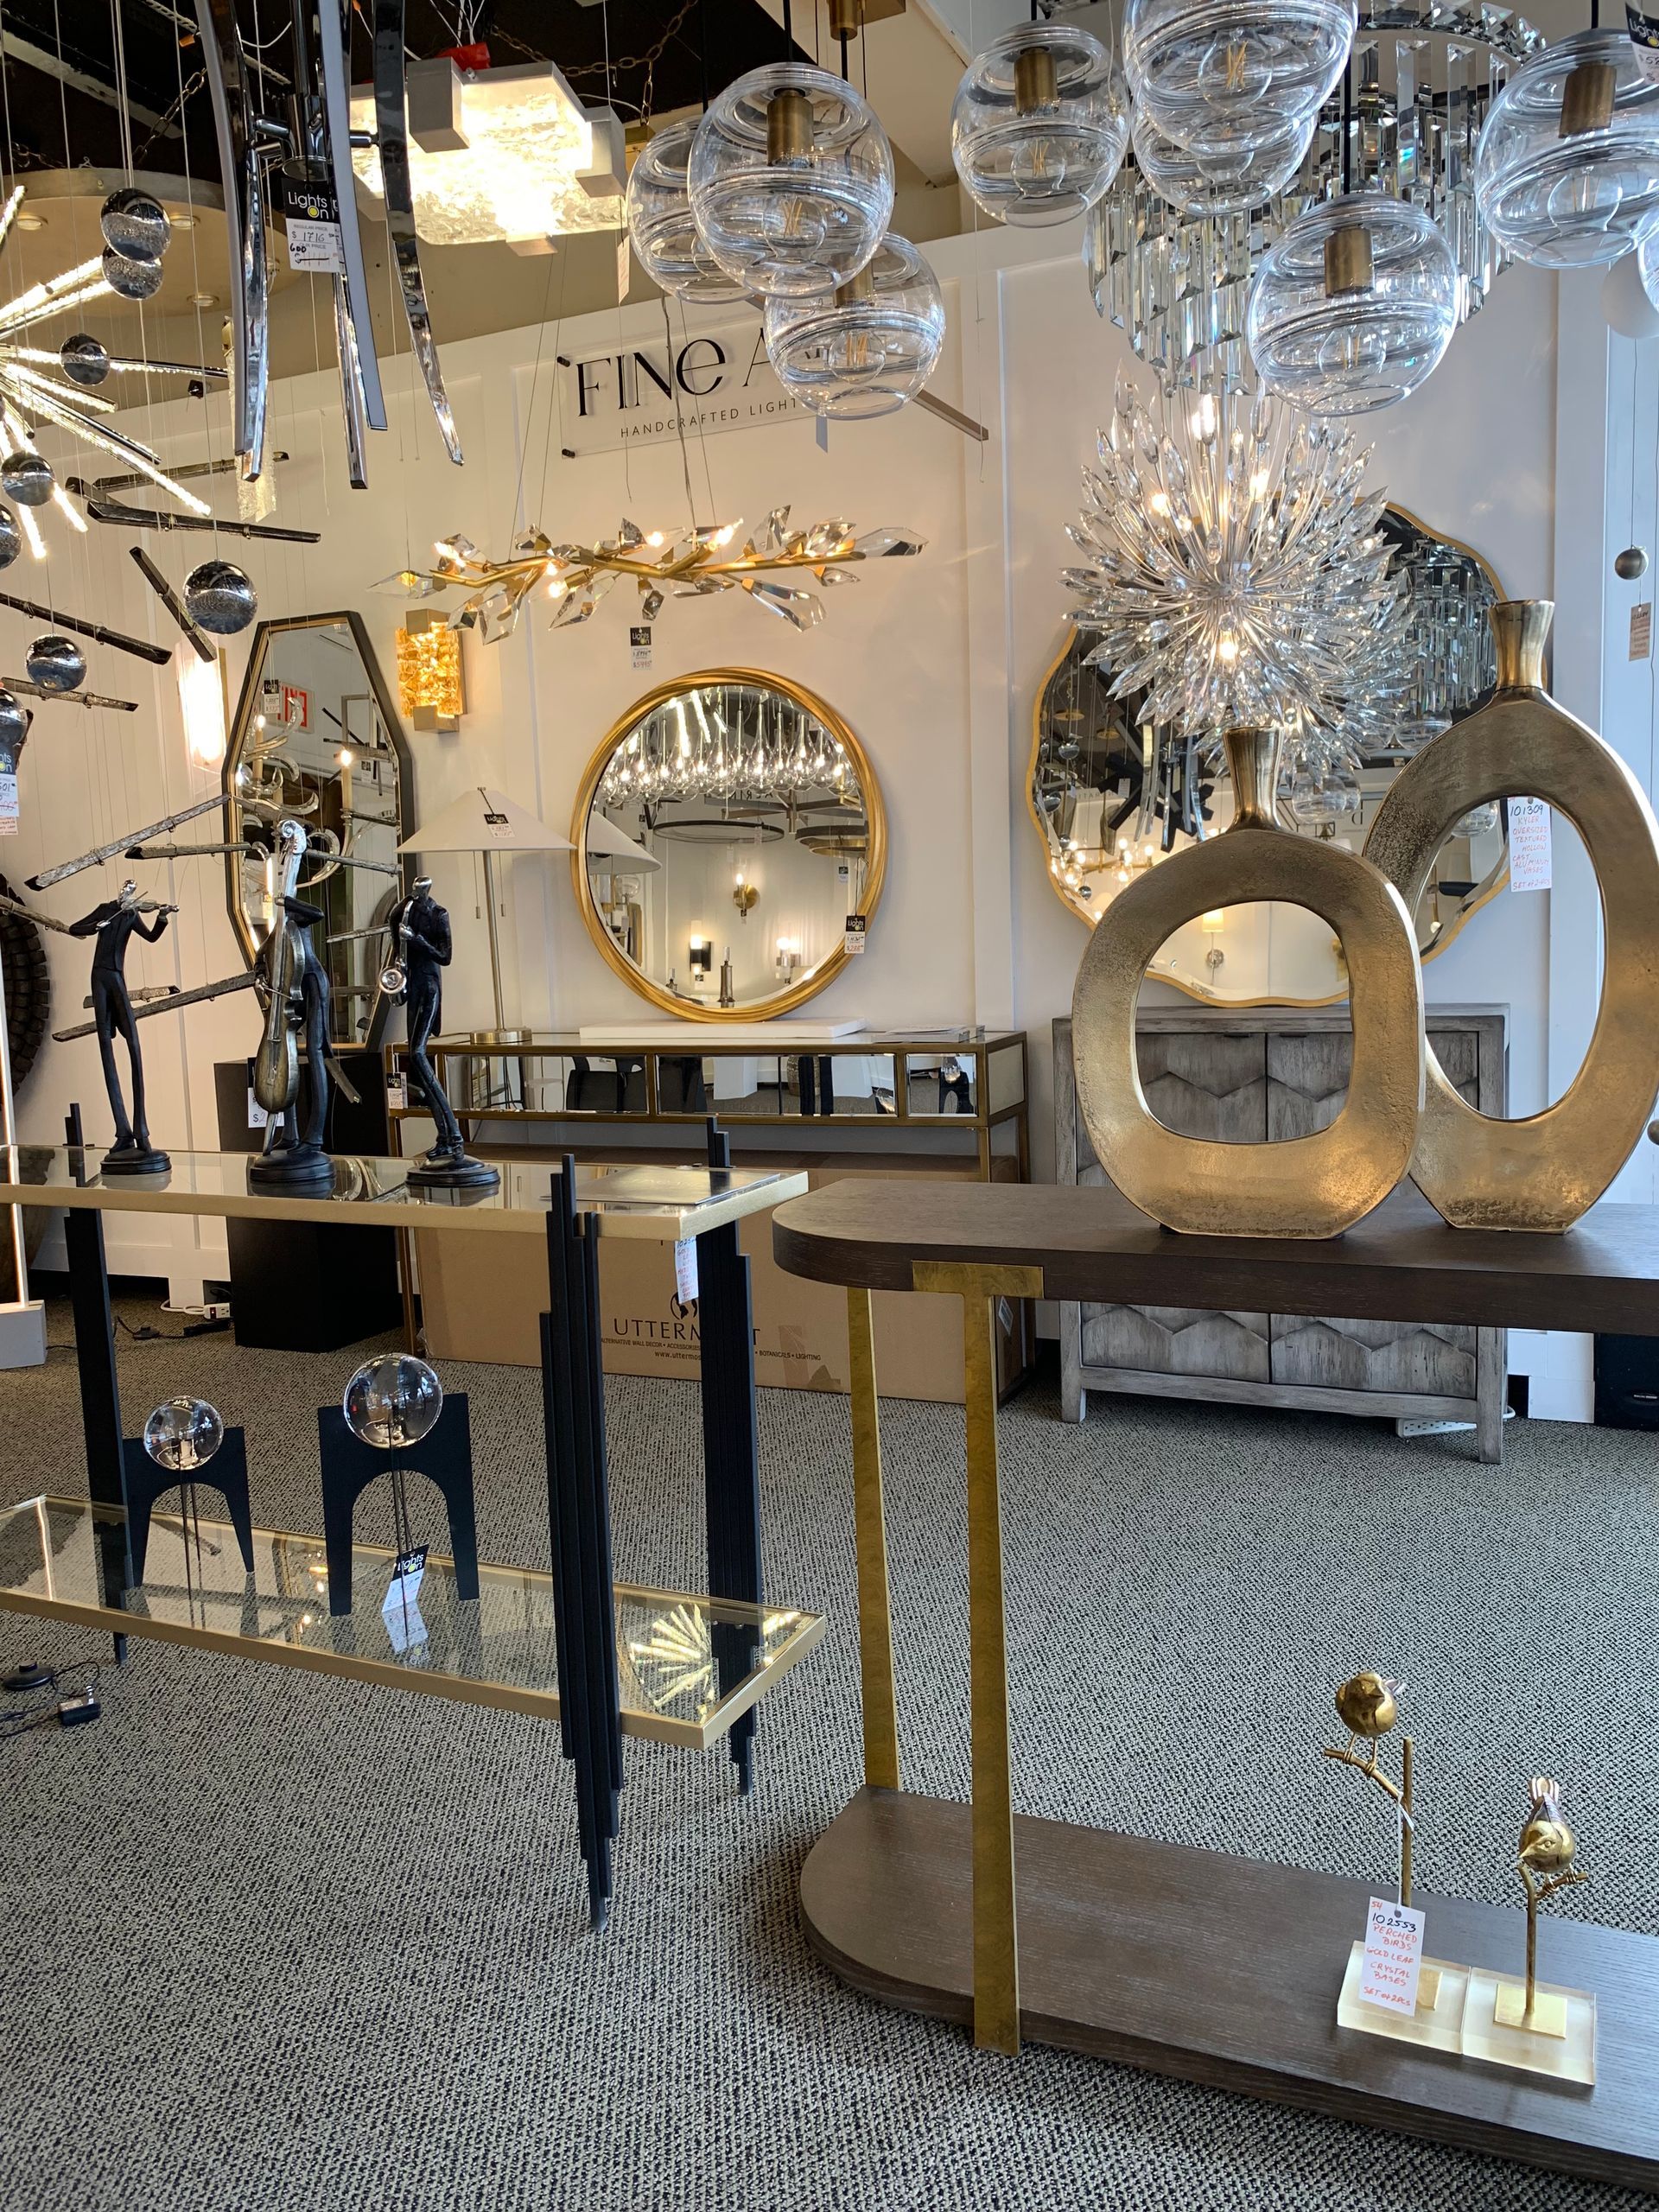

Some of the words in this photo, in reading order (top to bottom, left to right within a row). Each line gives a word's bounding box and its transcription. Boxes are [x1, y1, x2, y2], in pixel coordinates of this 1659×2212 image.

[288, 191, 327, 209] Lights
[307, 205, 329, 219] On
[620, 408, 739, 438] HANDCRAFTED
[749, 397, 796, 416] LIGHT
[1510, 804, 1543, 817] 101309
[613, 1319, 760, 1345] UTTERMT
[654, 1351, 702, 1360] www.uttermos
[760, 1350, 791, 1358] BOTANICALS
[1372, 1923, 1417, 1943] PERCHED
[1382, 1936, 1412, 1951] BIRDS
[1366, 1946, 1389, 1958] GOLD
[1391, 1953, 1414, 1964] LEAF
[1370, 1961, 1410, 1978] CRYSTAL
[1373, 1970, 1407, 1986] BASES
[1363, 1986, 1381, 1997] SET
